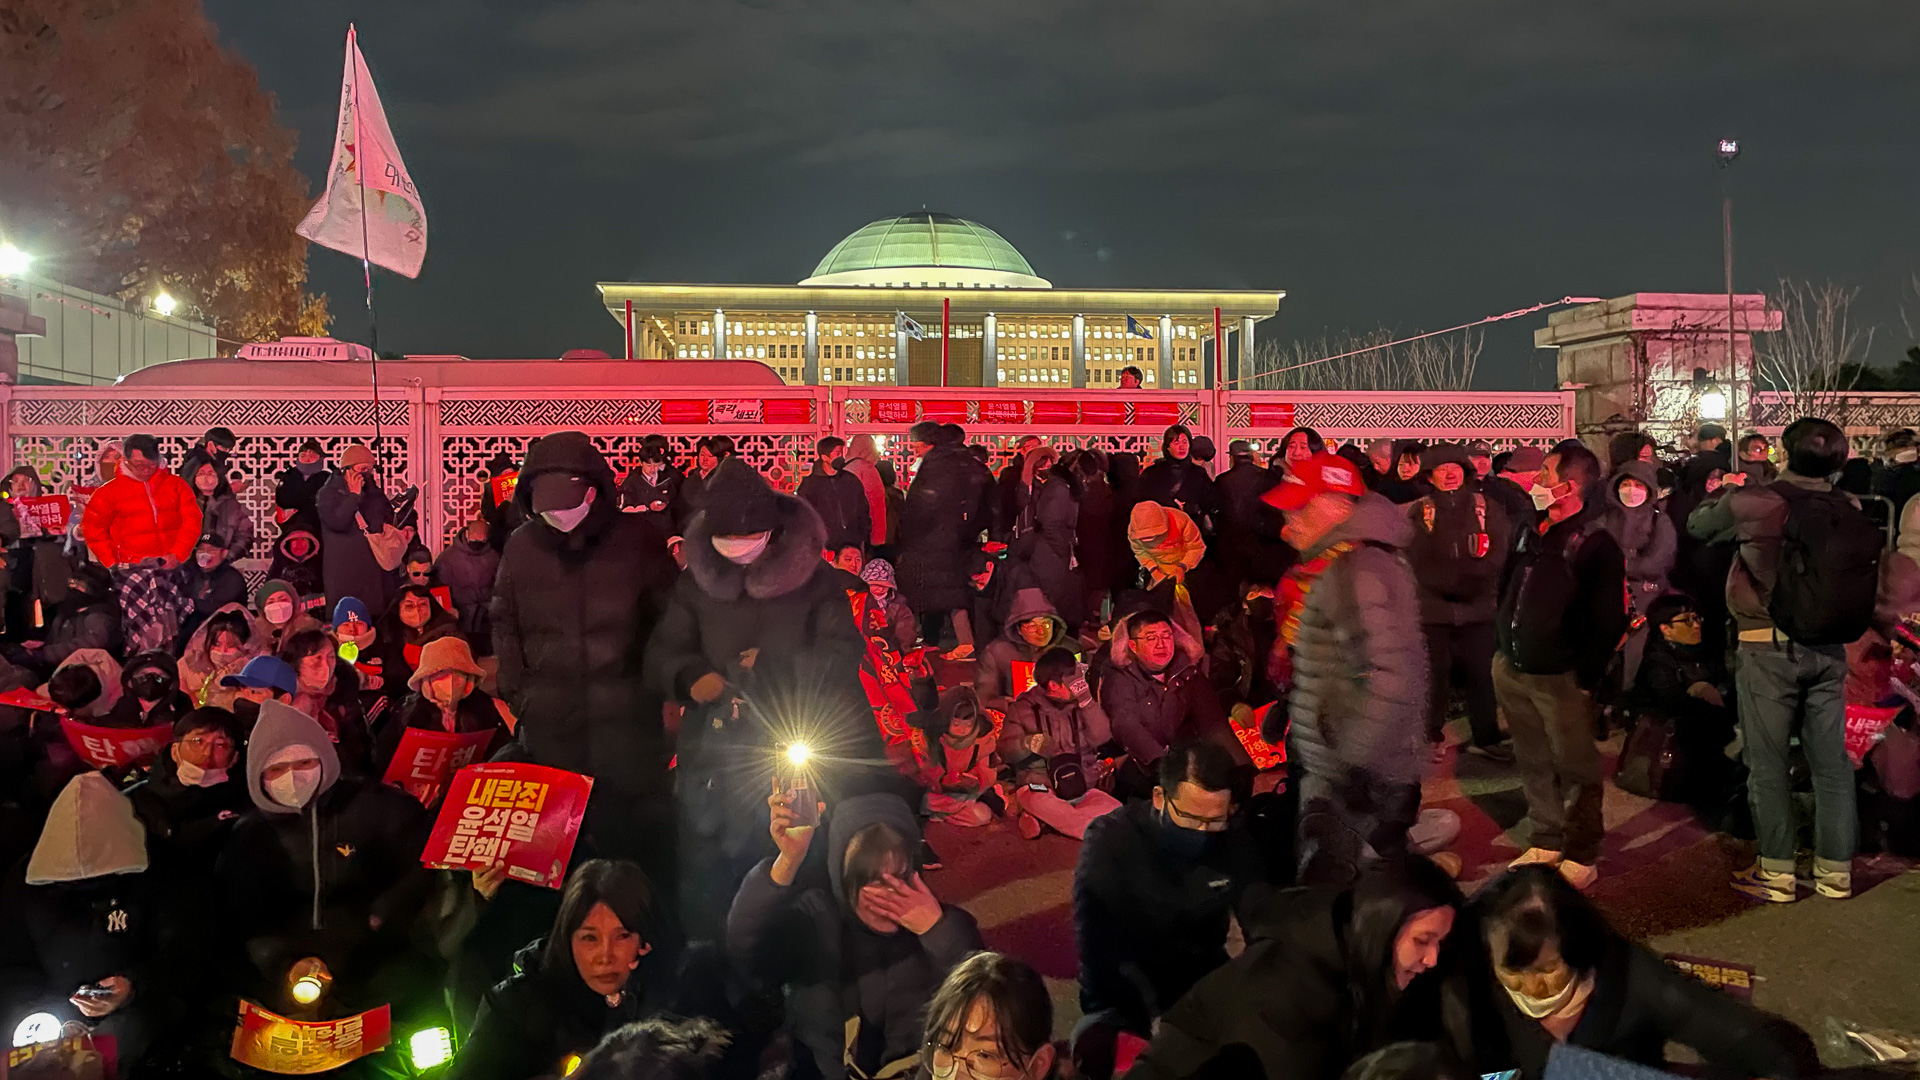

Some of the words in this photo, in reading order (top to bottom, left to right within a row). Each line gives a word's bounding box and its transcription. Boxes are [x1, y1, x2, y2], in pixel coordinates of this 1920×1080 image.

[715, 404, 737, 414] 즉각
[878, 402, 907, 410] 윤석열을
[987, 402, 1017, 410] 윤석열을
[733, 410, 758, 419] 체포!
[347, 610, 358, 622] LA
[466, 778, 550, 812] 내란죄
[455, 806, 540, 843] 윤석열
[443, 835, 511, 867] 탄핵!
[107, 909, 127, 932] NY
